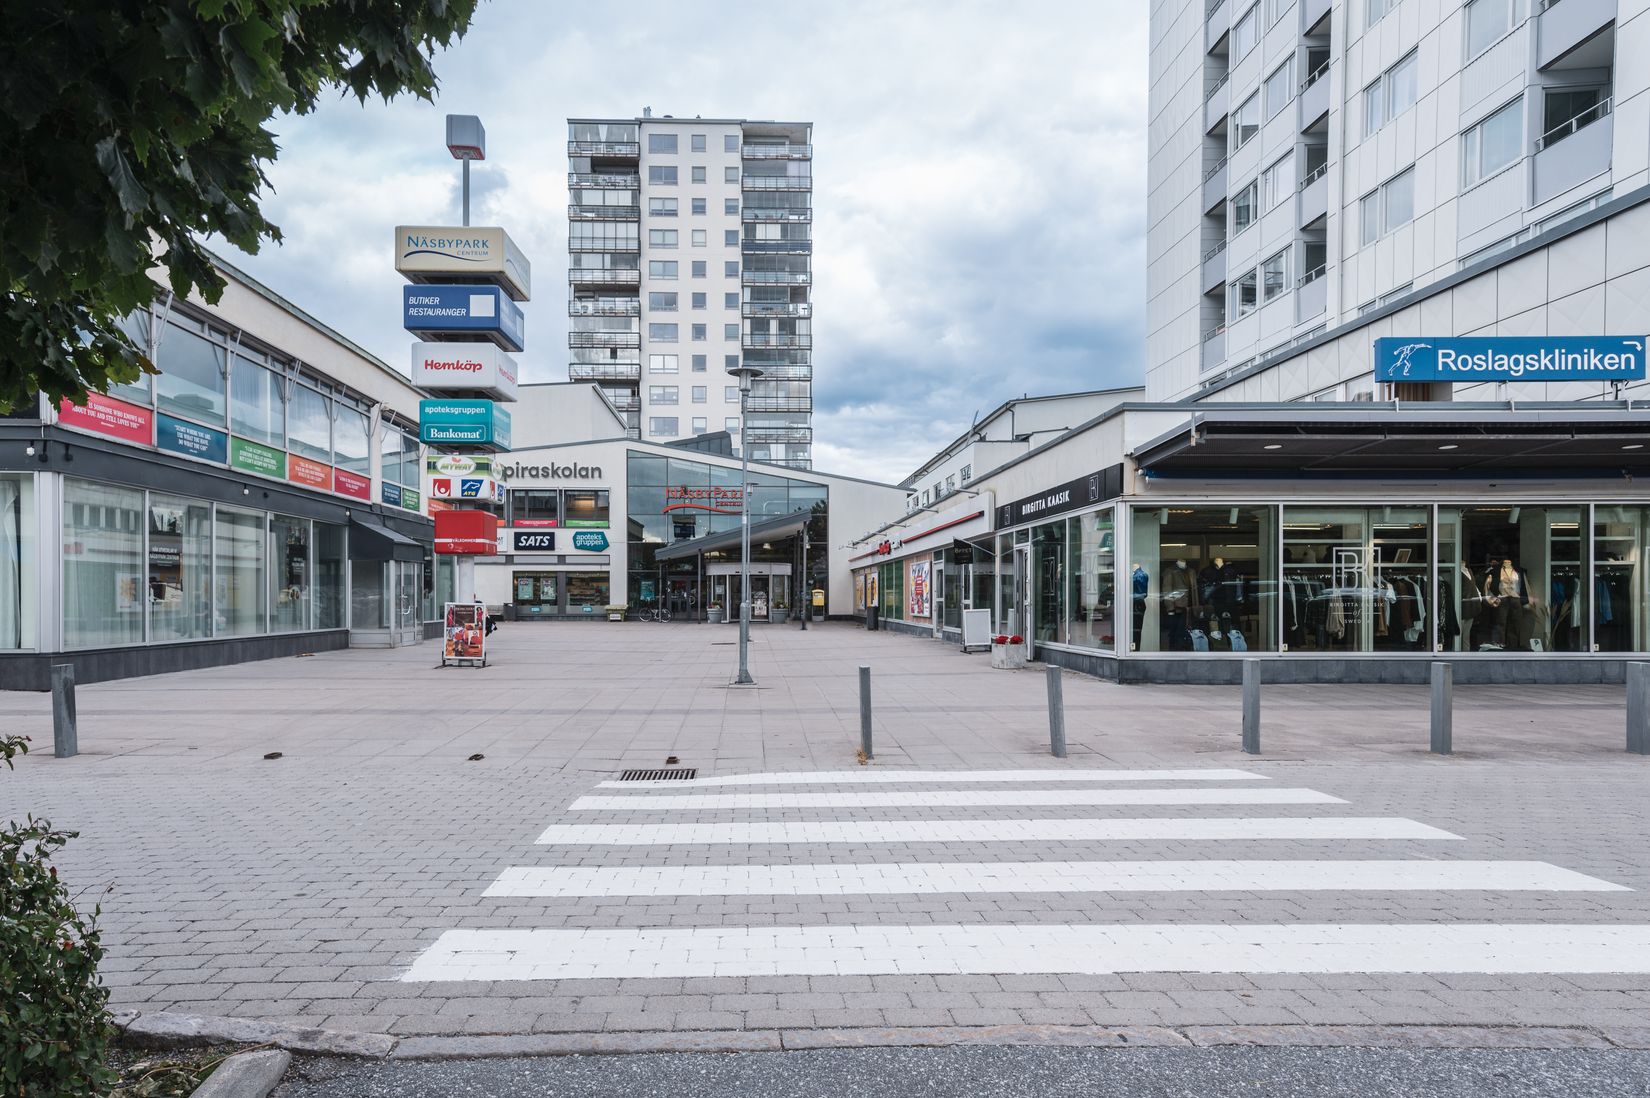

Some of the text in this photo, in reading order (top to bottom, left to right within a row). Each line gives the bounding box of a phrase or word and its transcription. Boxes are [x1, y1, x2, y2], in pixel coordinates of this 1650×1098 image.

[407, 235, 489, 249] NÄSBYPARK
[408, 296, 440, 305] BUTIKER
[408, 308, 467, 316] RESTAURANGER
[424, 359, 483, 373] Hemköp
[1437, 349, 1636, 376] Roslagskliniken
[424, 406, 486, 415] apoteksgruppen
[430, 428, 481, 439] Bankomat
[440, 463, 474, 471] MYWAY
[502, 462, 602, 482] piraskolan
[666, 485, 743, 499] NÄSBYPAR
[1022, 490, 1070, 515] BIRGITTA KAASIK
[518, 535, 551, 547] SATS
[575, 532, 602, 541] apoteks
[575, 539, 604, 547] gruppen
